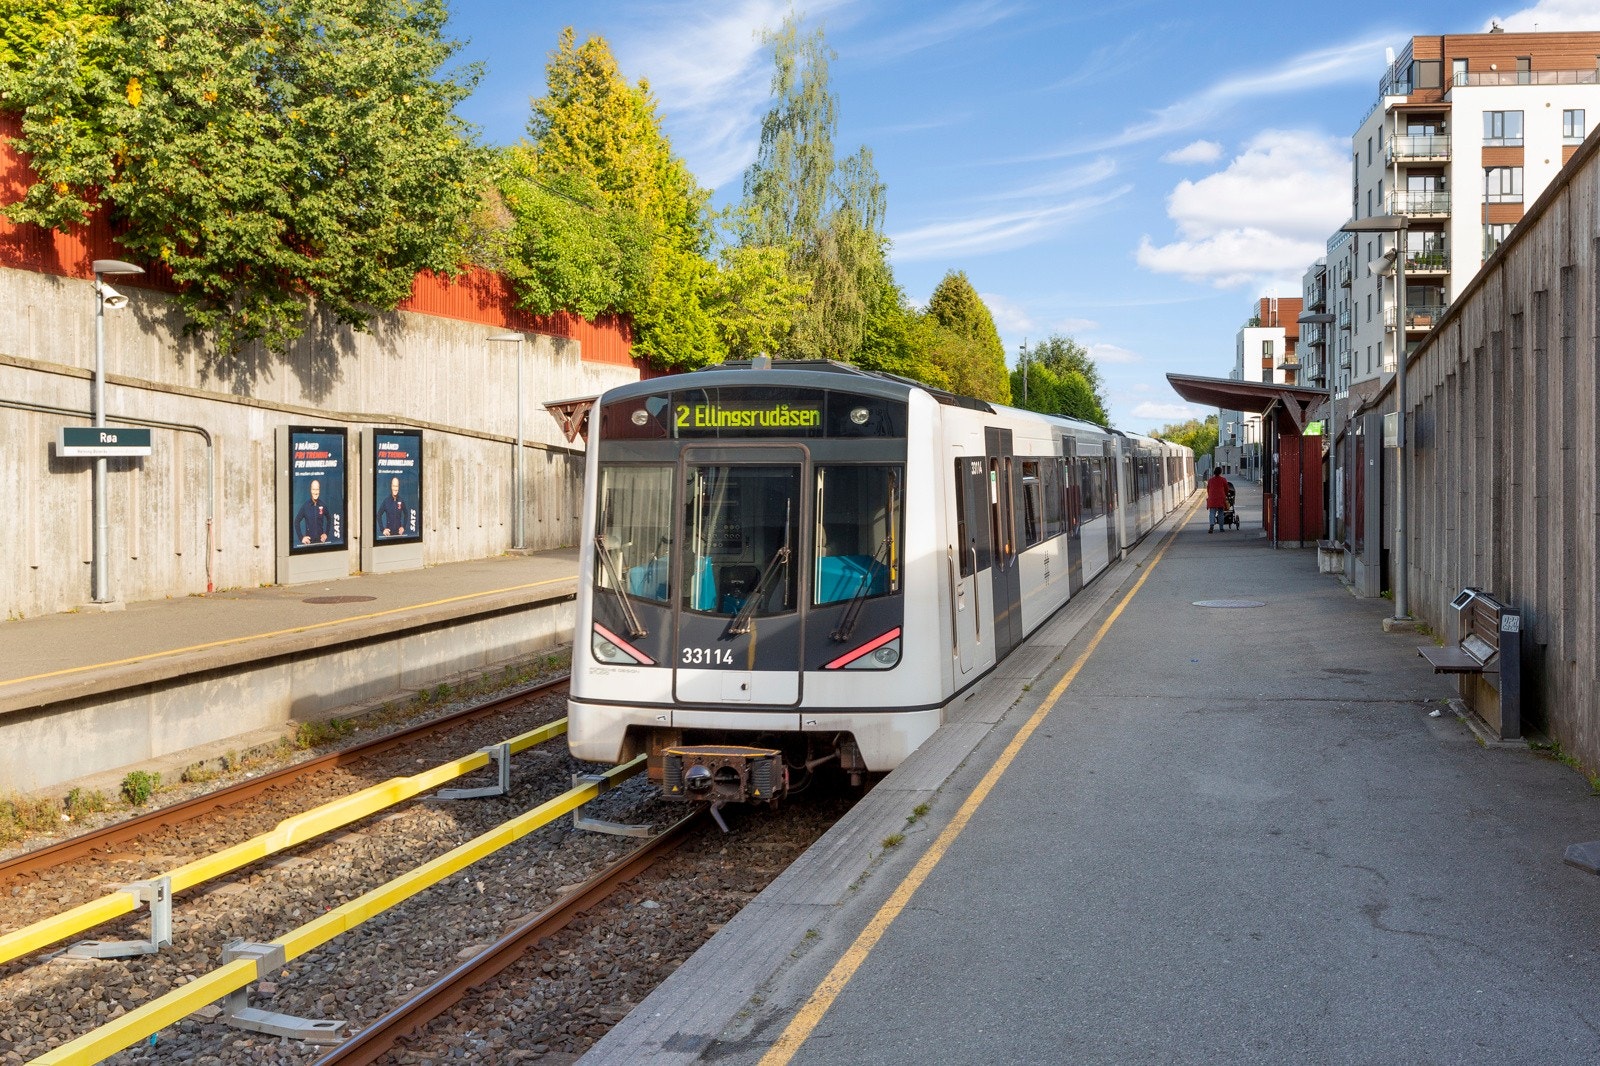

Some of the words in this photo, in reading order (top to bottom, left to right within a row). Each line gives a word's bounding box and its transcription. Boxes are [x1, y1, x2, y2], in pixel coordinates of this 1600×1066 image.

[677, 405, 690, 427] 2
[695, 404, 820, 427] Ellingsrudåsen
[100, 432, 118, 443] Røa
[333, 513, 341, 539] SATS
[682, 647, 734, 665] 33114
